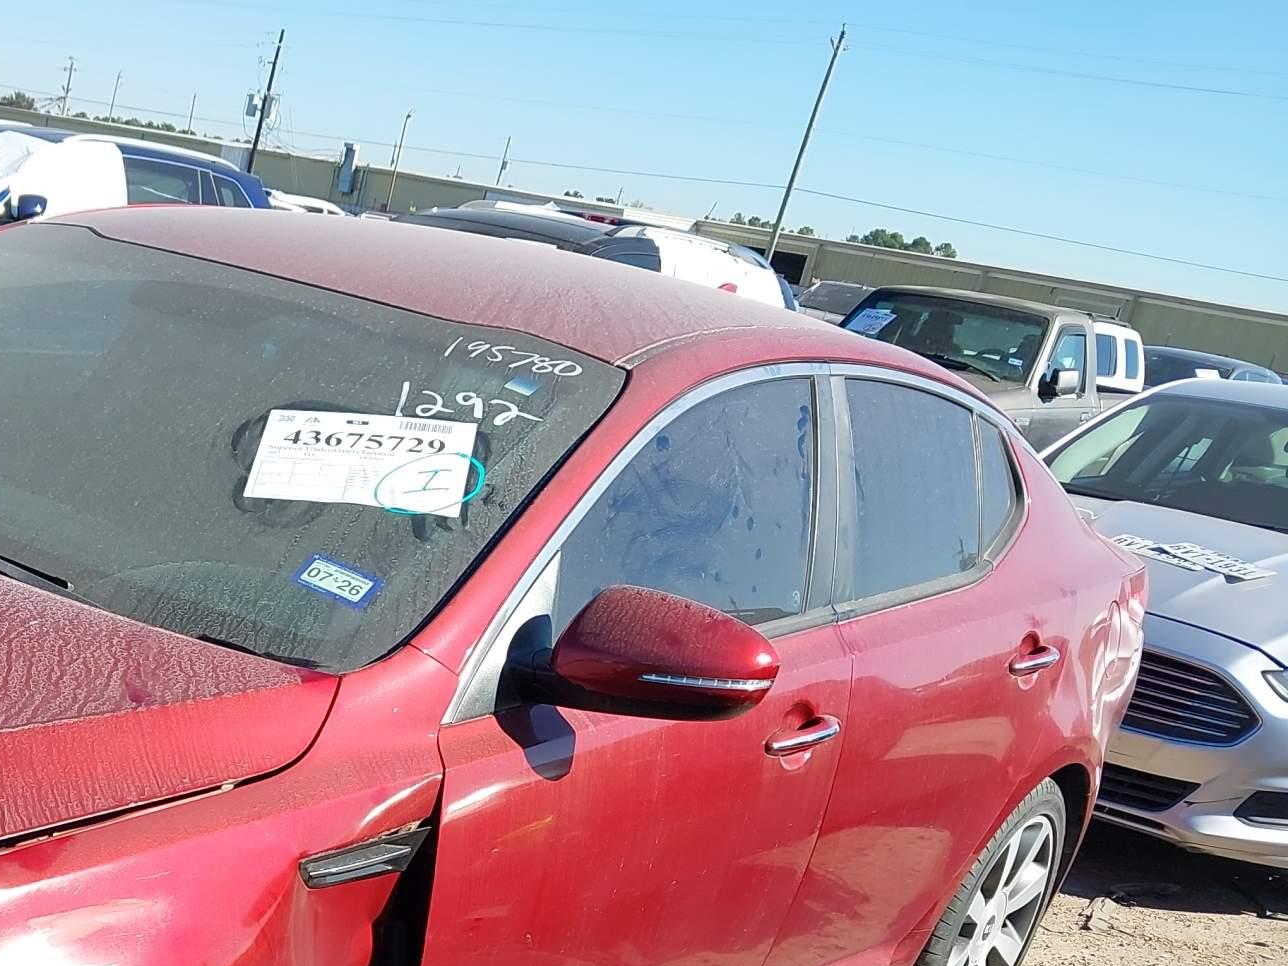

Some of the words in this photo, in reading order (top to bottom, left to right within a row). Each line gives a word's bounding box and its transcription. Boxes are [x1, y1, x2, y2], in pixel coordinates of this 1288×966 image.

[443, 336, 583, 377] 195780
[395, 381, 544, 427] 1292
[283, 430, 446, 454] 43675729
